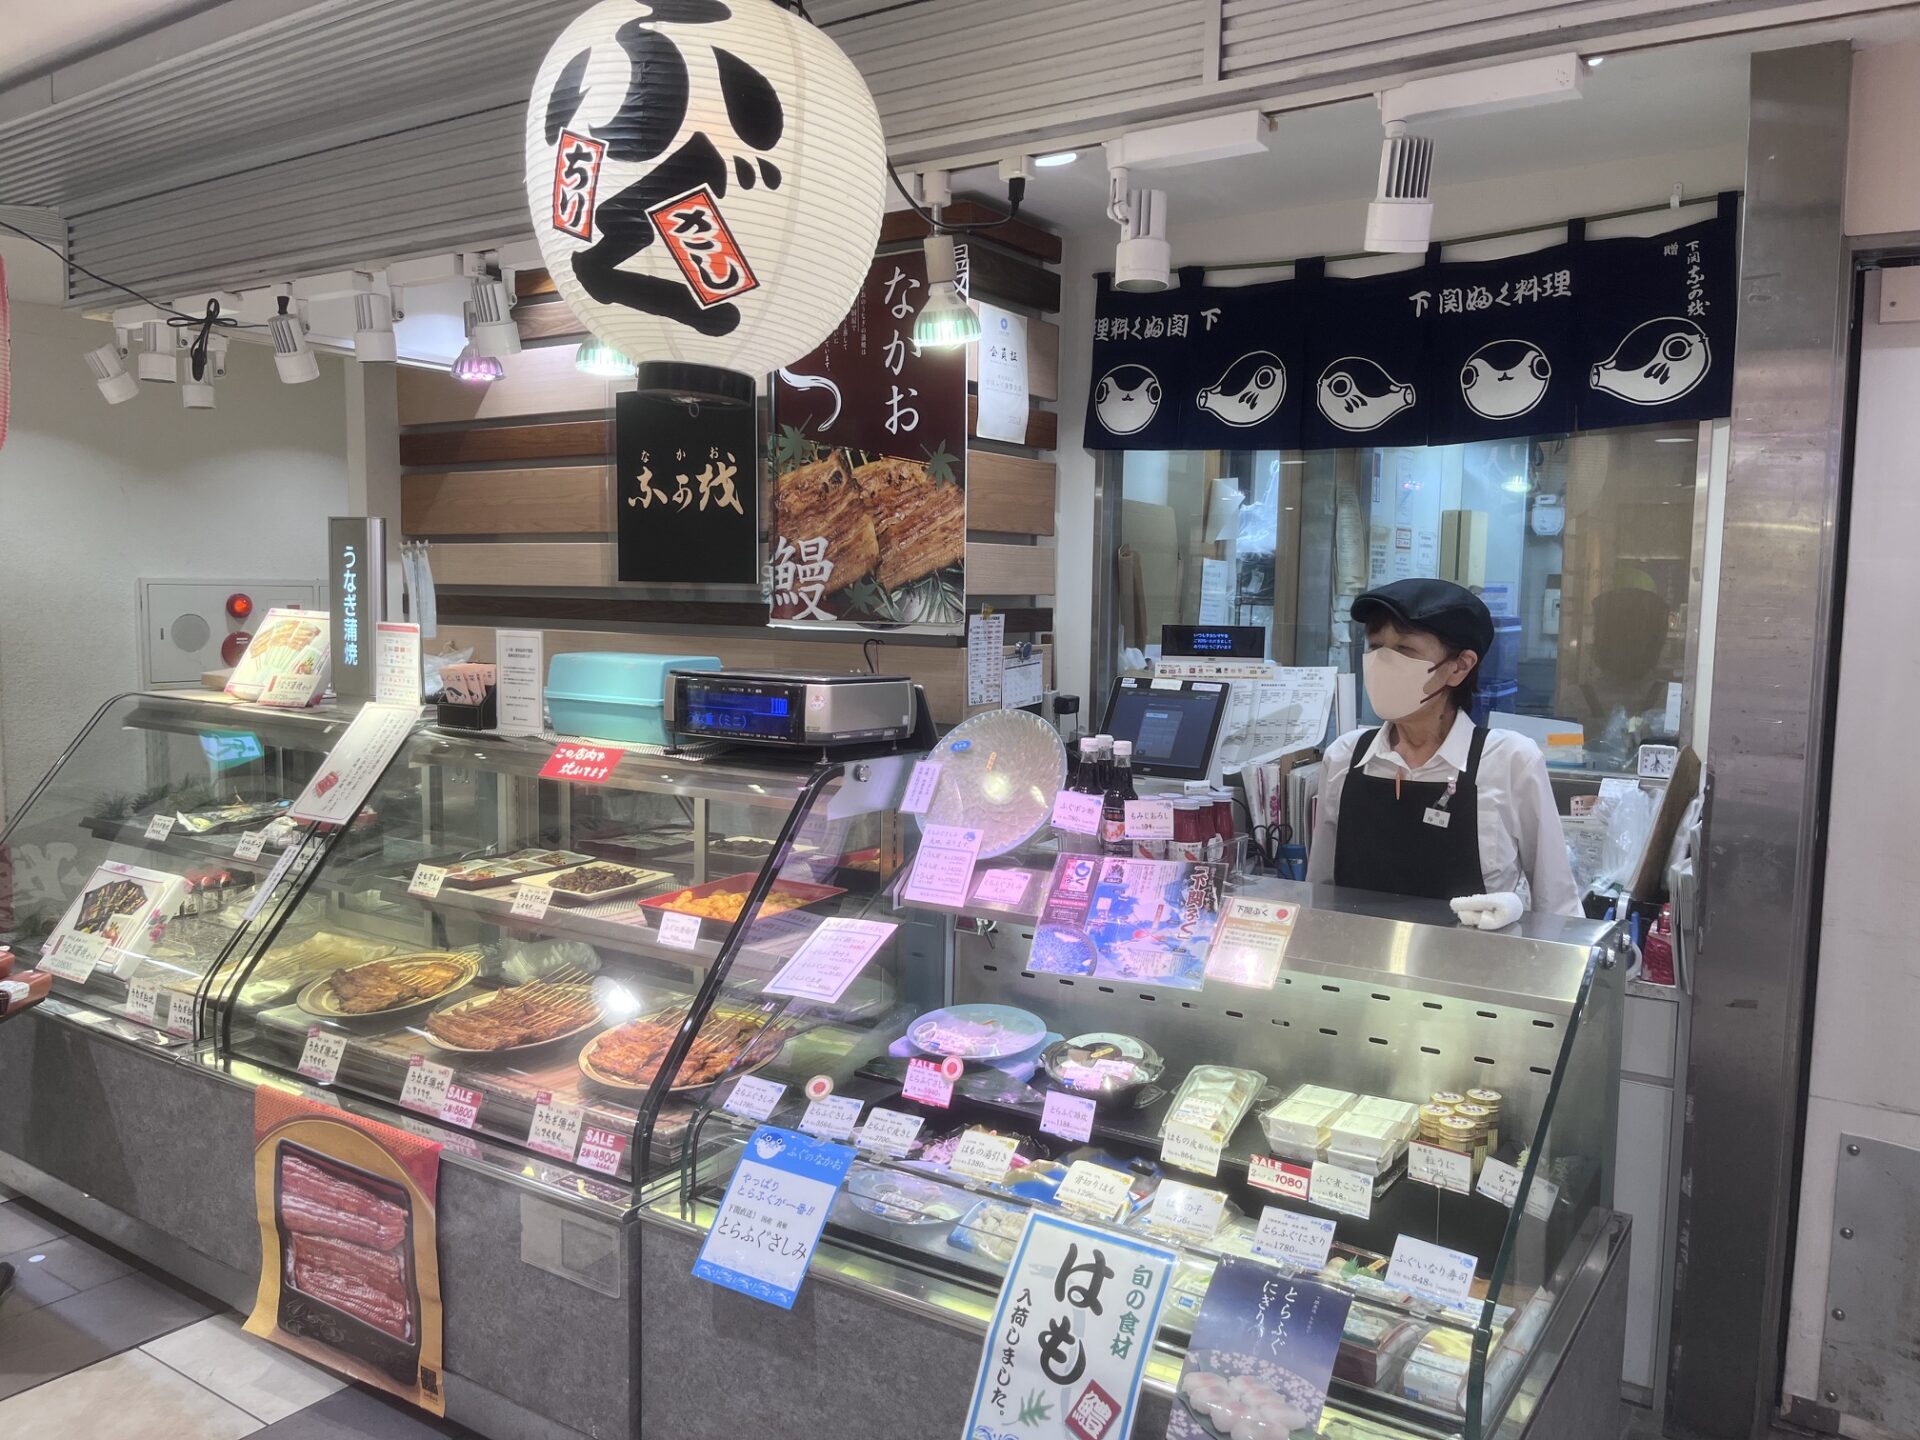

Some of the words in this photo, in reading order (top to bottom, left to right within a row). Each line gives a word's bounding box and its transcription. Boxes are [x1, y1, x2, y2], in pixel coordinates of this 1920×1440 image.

[560, 142, 594, 228] ちり
[883, 266, 921, 434] なかお
[771, 535, 838, 621] 鰻
[343, 545, 358, 666] うなぎ蒲焼
[1130, 811, 1168, 819] もみじおろし
[909, 1058, 935, 1070] SALE
[411, 1071, 445, 1092] うなぎ蒲焼
[447, 1085, 473, 1104] SALE
[538, 1110, 577, 1134] うなぎ蒲焼
[585, 1129, 616, 1148] SALE
[787, 1147, 844, 1171] ふぐのなかお
[1250, 1154, 1282, 1171] SALE
[743, 1173, 780, 1191] やっぱり
[717, 1216, 808, 1261] とらふぐさしみ
[1261, 1223, 1326, 1248] とらふぐにぎり
[1393, 1252, 1469, 1285] ふぐいなり寿司
[1037, 1242, 1115, 1386] はも
[1109, 1264, 1154, 1360] 旬の食材
[1255, 1280, 1280, 1337] にぎり
[1270, 1286, 1298, 1357] とらふぐ
[990, 1287, 1033, 1417] 入荷しました。
